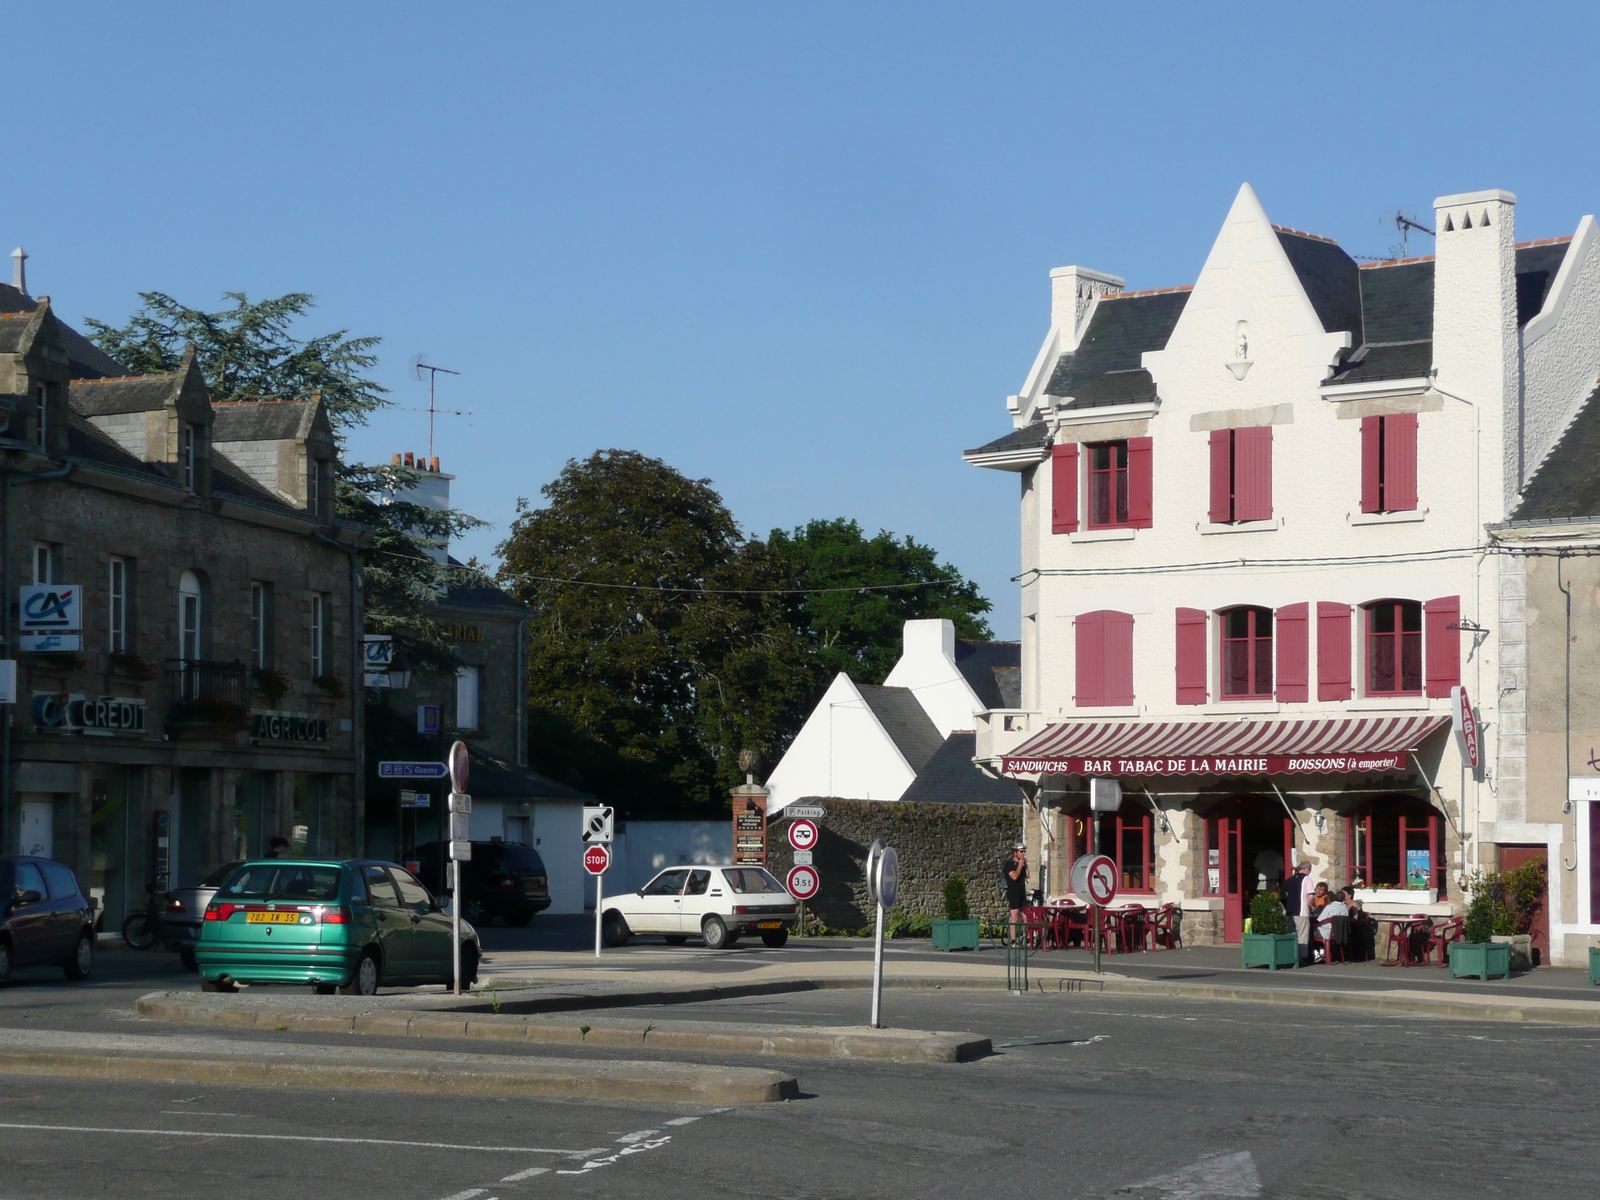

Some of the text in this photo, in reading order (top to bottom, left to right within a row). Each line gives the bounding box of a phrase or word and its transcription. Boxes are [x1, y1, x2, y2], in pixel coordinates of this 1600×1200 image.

[1460, 694, 1476, 759] TABAC
[1007, 756, 1398, 772] SANDWICHS BAR TABAC DE LA MAIRIE BOISSONS (à emporter)
[414, 766, 438, 775] Guesny
[796, 808, 820, 818] Parking
[586, 855, 606, 865] STOP
[250, 913, 265, 922] 702
[284, 914, 295, 922] 35
